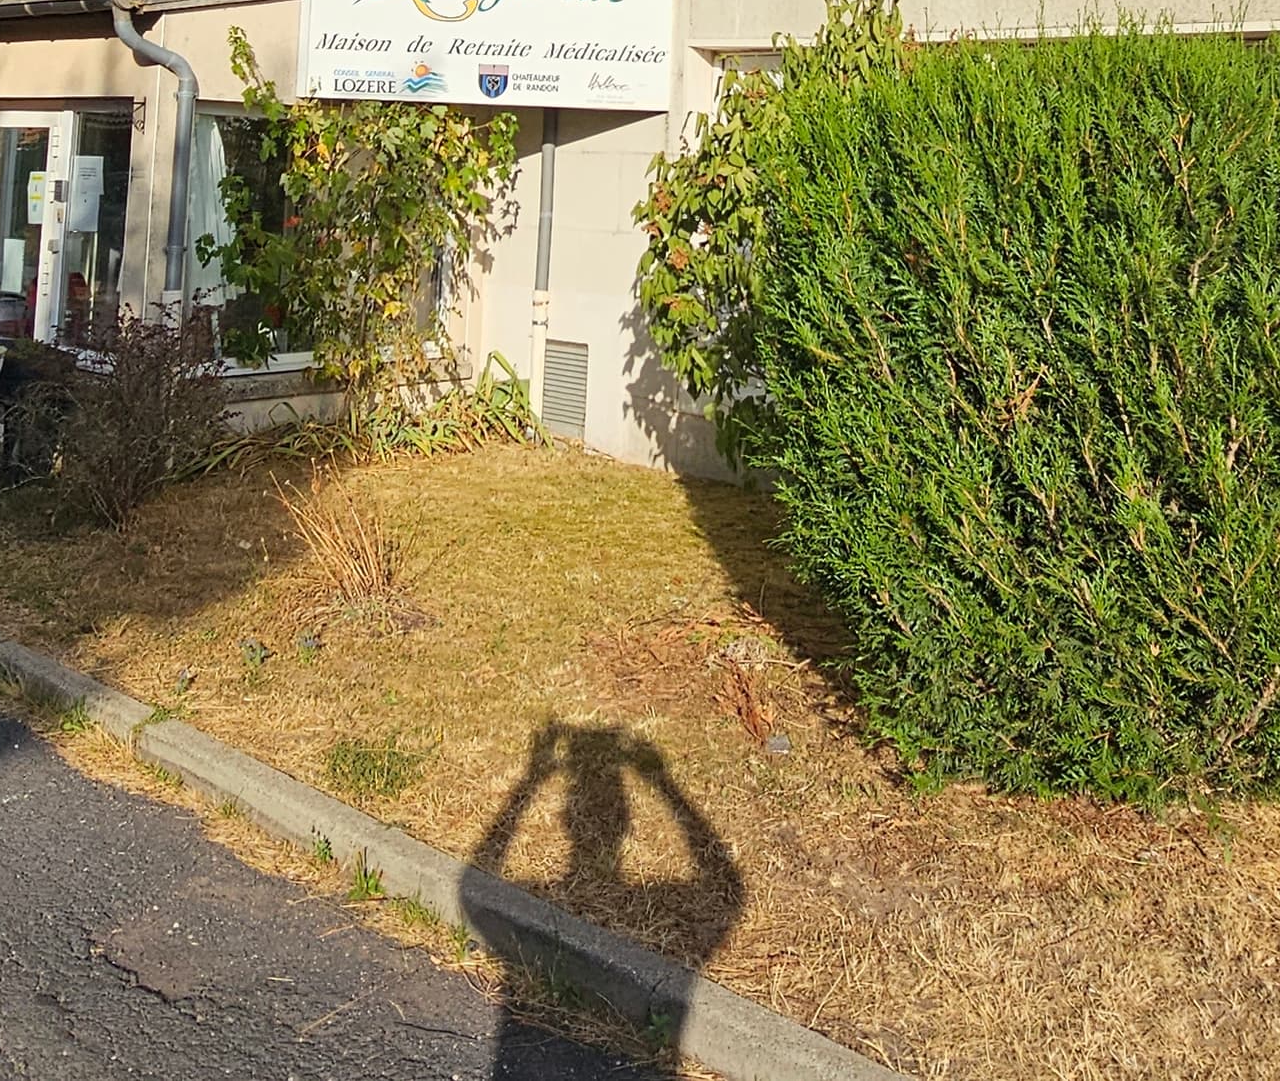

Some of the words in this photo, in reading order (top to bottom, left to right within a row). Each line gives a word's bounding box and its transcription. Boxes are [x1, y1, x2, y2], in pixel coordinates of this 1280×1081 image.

[315, 32, 392, 53] Maison
[406, 35, 433, 54] de
[447, 37, 533, 58] Retraite
[544, 42, 667, 64] Médicalisée
[511, 73, 561, 83] CHATEAUNEUF
[334, 78, 397, 94] LOZERE
[512, 83, 522, 92] DE
[526, 84, 559, 93] RANDON
